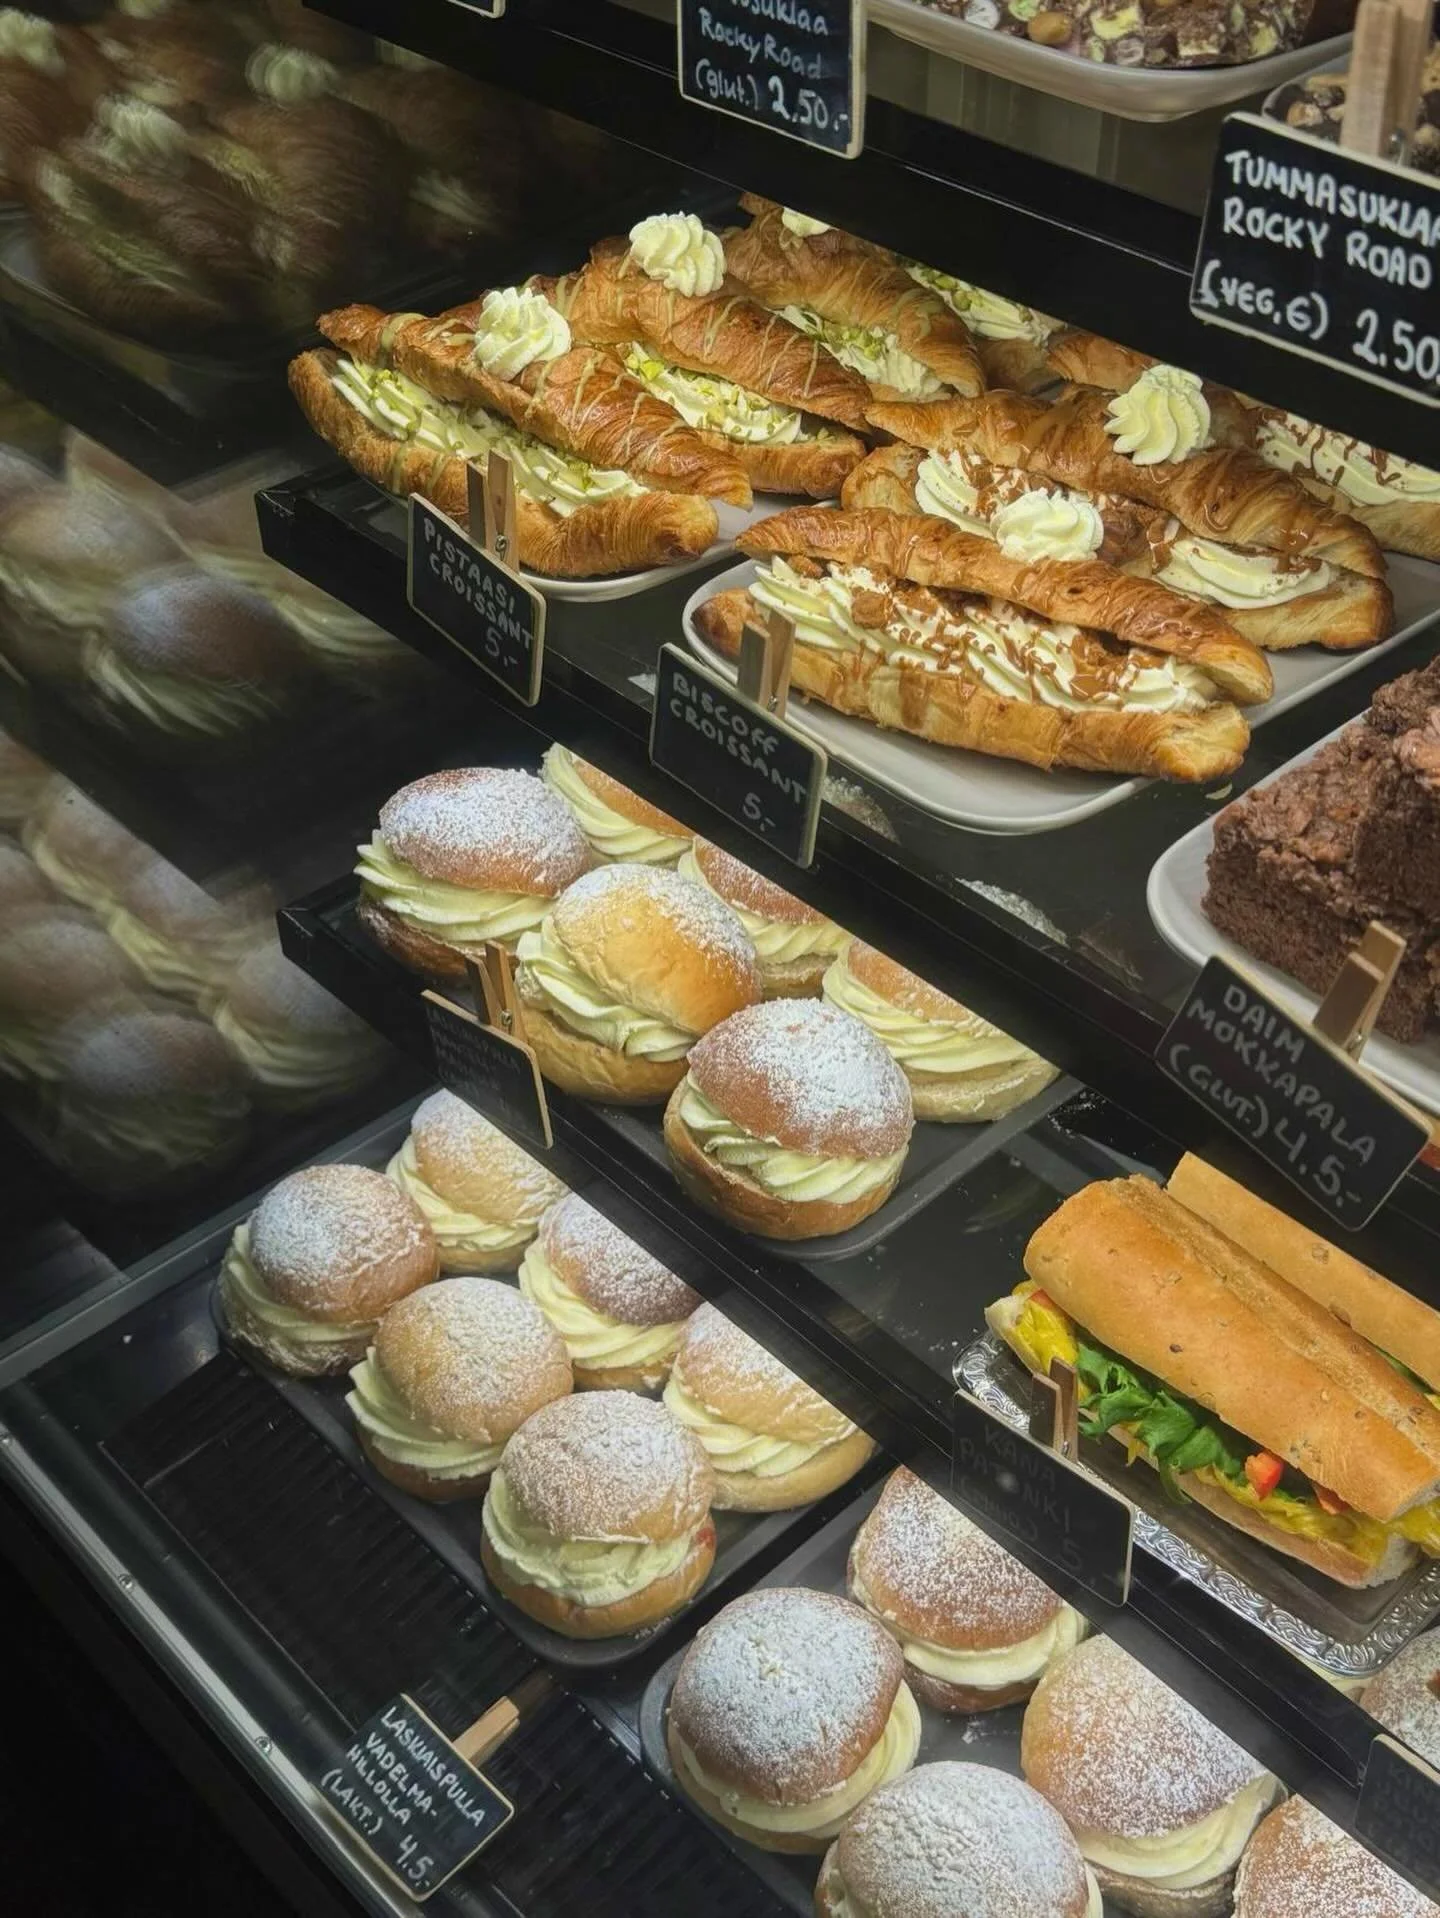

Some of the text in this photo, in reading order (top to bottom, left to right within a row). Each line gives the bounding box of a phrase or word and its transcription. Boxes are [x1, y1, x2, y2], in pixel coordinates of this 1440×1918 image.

[698, 7, 822, 79] Rocky Road
[1223, 197, 1432, 289] ROCKY ROAD
[423, 517, 515, 614] PISTAASI
[429, 552, 533, 649] CROISSANT
[670, 699, 806, 804] CROISSANT
[1223, 984, 1305, 1063] DAIM
[1187, 1000, 1376, 1166] MOKKAPALA
[320, 1768, 383, 1836] (LAKT.)
[346, 1744, 412, 1825] HILLOLLA
[366, 1732, 437, 1817] VADELMA-
[380, 1706, 486, 1827] LASKIAISPULLA
